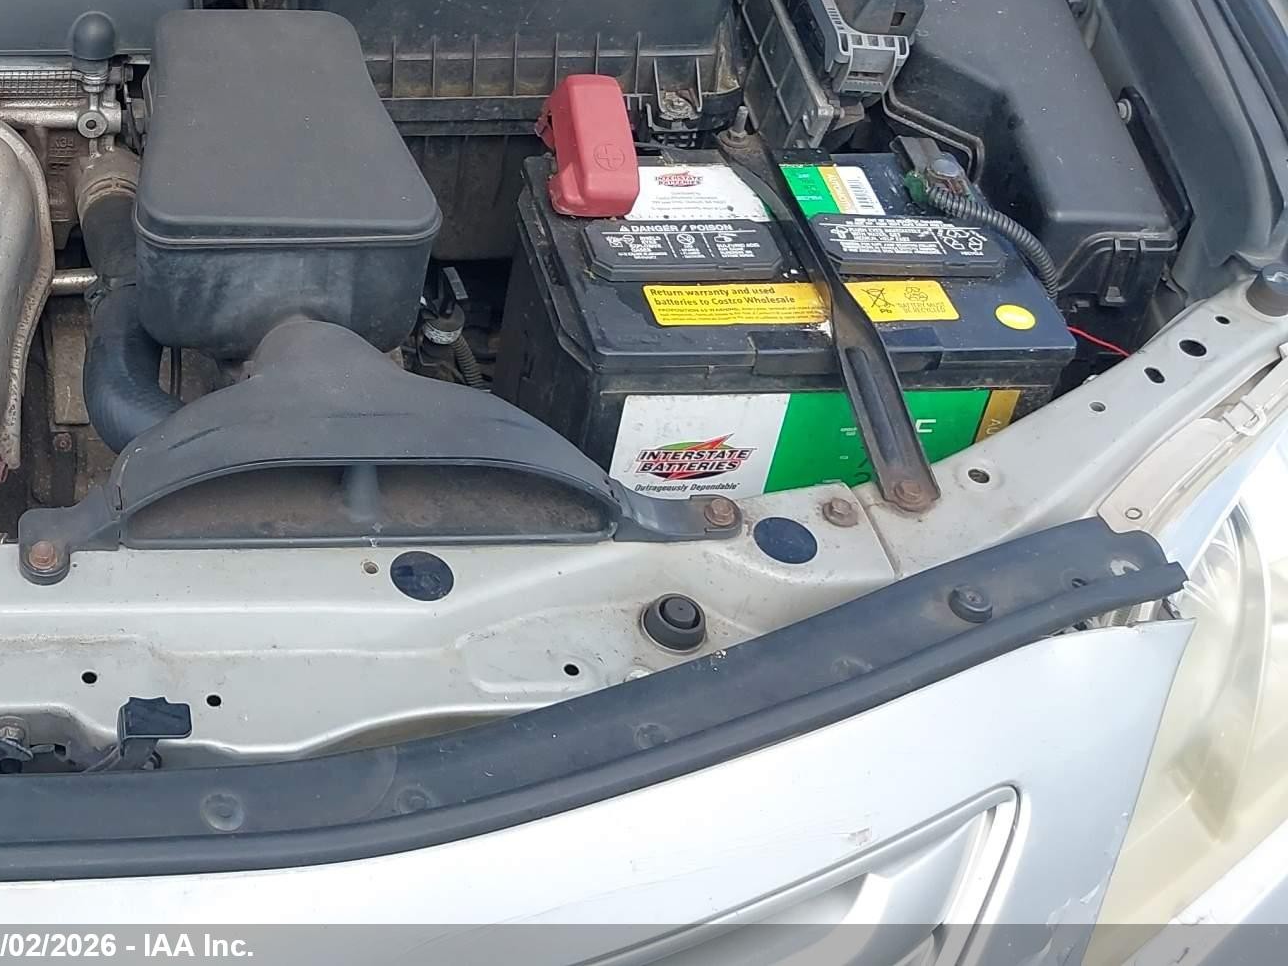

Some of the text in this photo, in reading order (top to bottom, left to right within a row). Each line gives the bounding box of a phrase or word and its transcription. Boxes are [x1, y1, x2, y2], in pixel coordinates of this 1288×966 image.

[631, 224, 679, 232] DANGER
[650, 288, 684, 296] Return
[685, 289, 729, 298] warranty
[732, 287, 750, 295] and
[654, 297, 697, 306] batteries
[744, 296, 796, 304] Wholesale
[639, 449, 751, 460] INTERSTATE
[639, 461, 738, 472] BATTERIES
[634, 483, 737, 492] Outrageously Dependable
